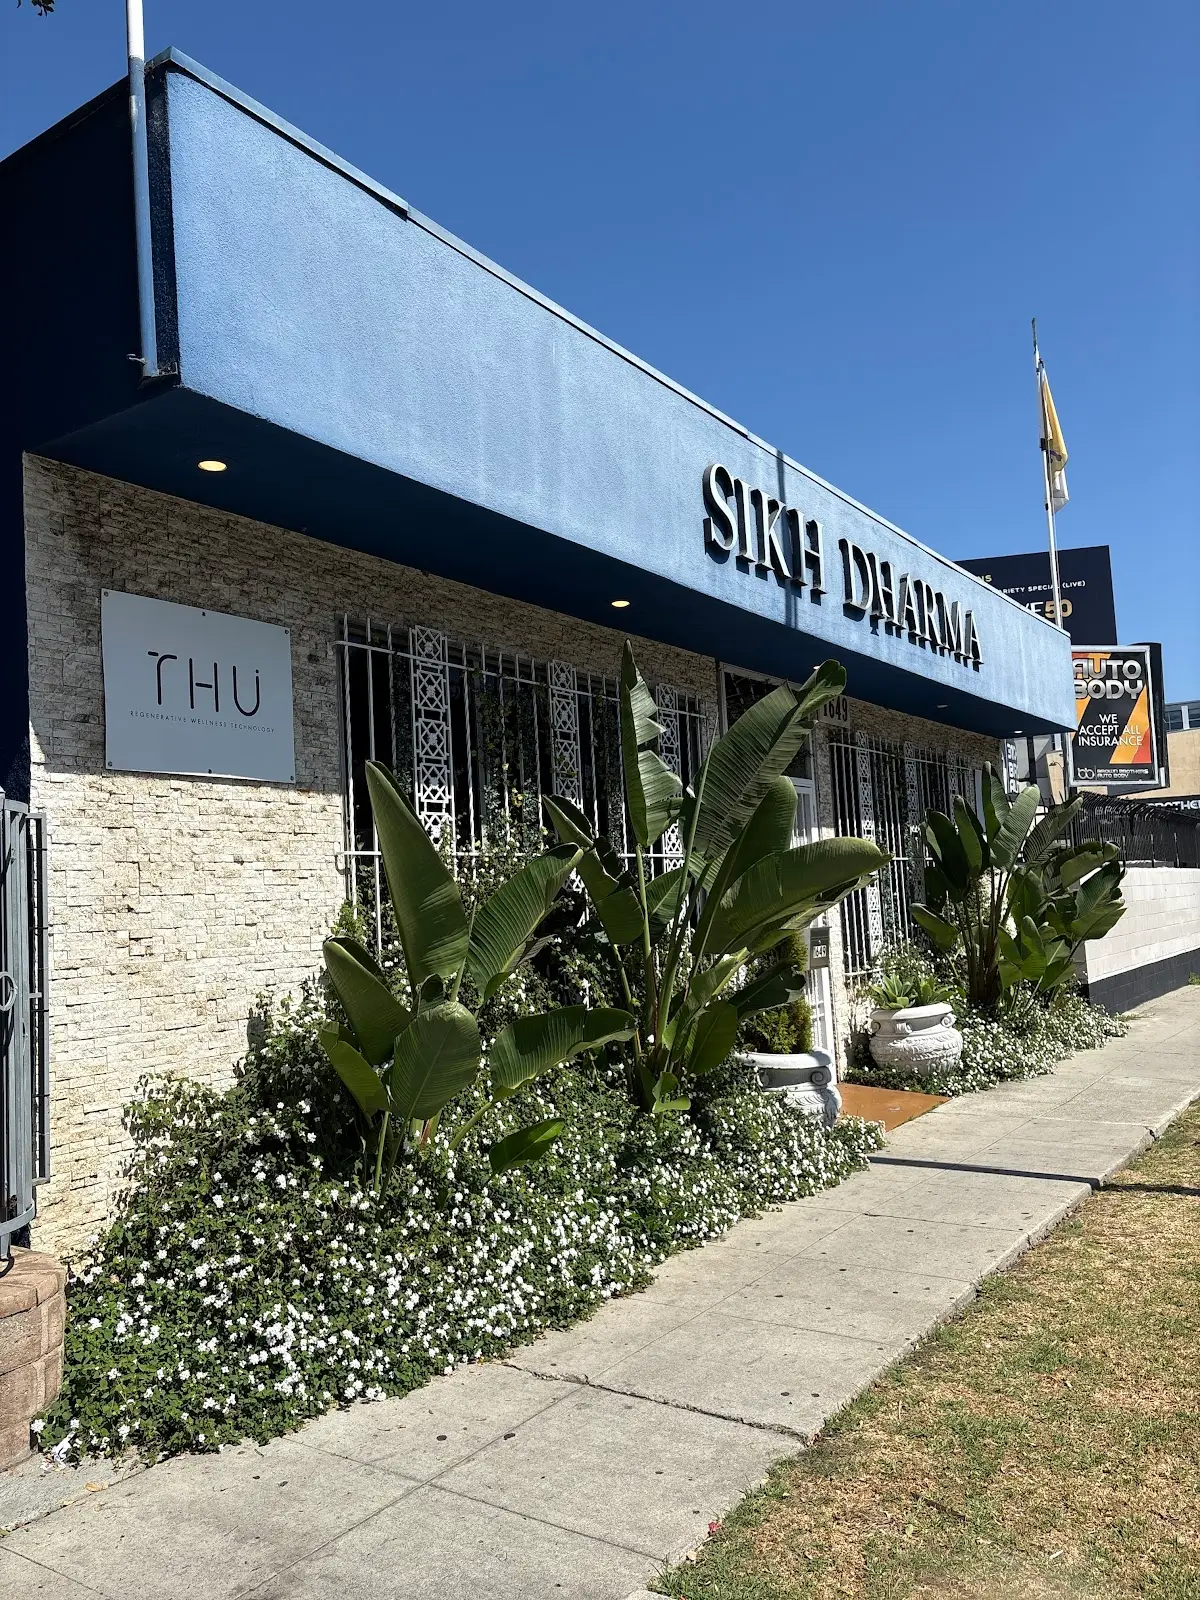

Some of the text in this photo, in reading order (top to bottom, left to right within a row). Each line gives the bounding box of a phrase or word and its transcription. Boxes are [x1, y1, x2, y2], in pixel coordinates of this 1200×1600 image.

[702, 463, 984, 664] SIKH DHARMA
[1062, 580, 1085, 589] (LIVE)
[1073, 659, 1141, 680] AUTO
[148, 651, 260, 716] THU
[1074, 679, 1142, 699] BODY
[823, 695, 848, 722] 1649
[1099, 713, 1118, 724] WE
[130, 710, 275, 734] REGENERATIVE WELLNESS TECHNOLOGY
[1078, 724, 1140, 735] ACCEPT ALL
[1078, 736, 1143, 746] INSURANCE
